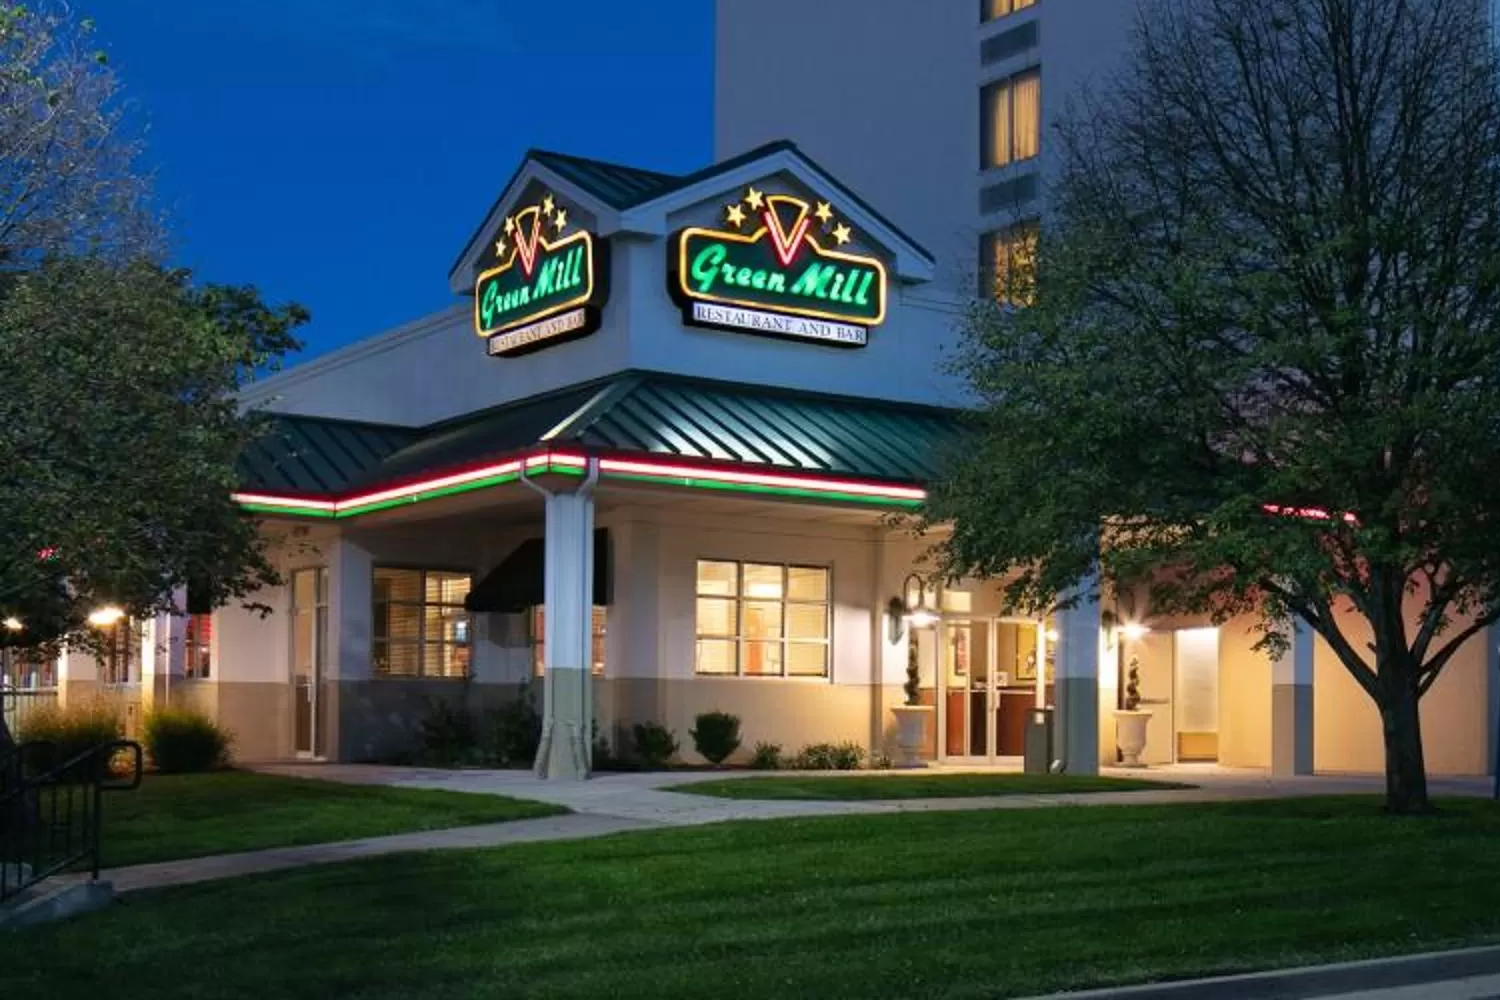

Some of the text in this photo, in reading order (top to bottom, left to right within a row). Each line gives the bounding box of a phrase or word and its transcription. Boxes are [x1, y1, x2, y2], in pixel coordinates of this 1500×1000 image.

[482, 246, 584, 329] Green Mill
[691, 243, 875, 305] Green Mill
[696, 305, 865, 343] RESTAURANT AND BAR
